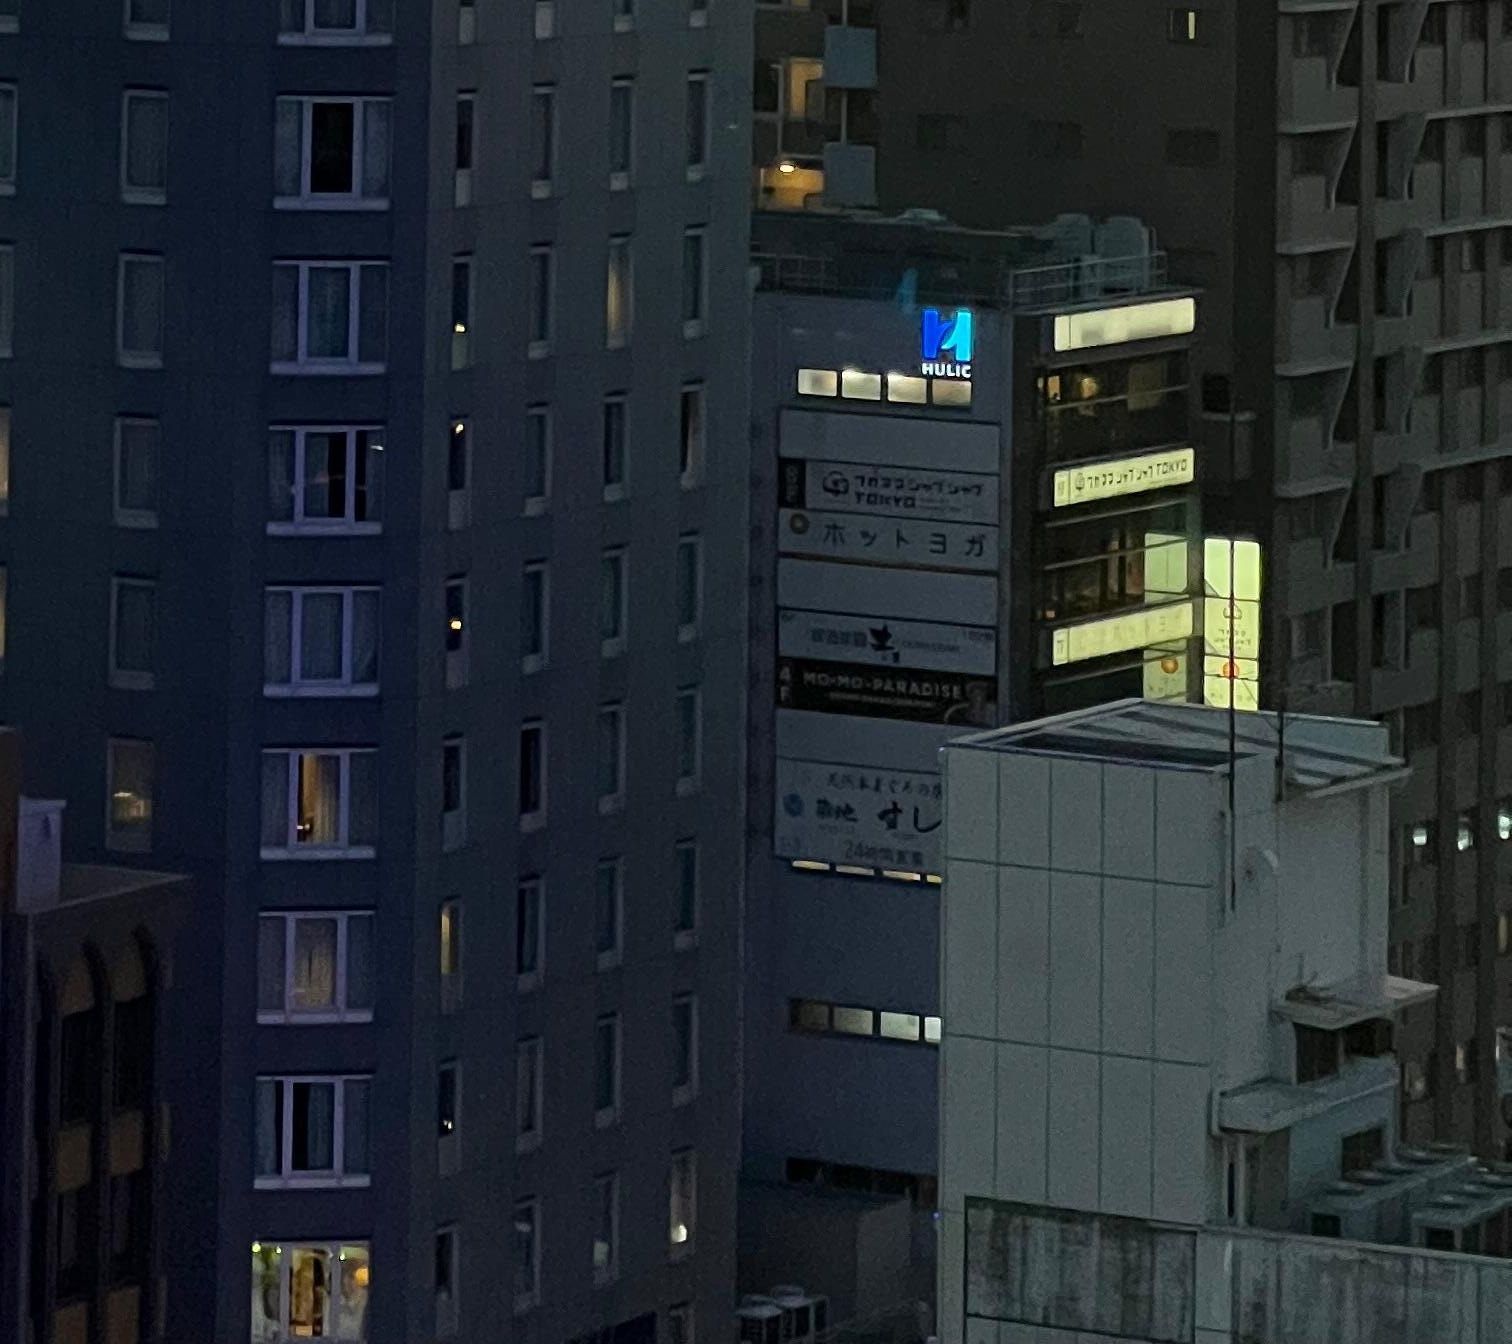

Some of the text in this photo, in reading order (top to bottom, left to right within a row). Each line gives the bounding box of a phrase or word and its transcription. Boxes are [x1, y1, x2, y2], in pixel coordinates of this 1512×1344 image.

[921, 362, 972, 379] HULIC
[854, 491, 917, 509] TOKYO
[823, 522, 987, 557] ホットヨガ
[803, 671, 962, 699] MO-MO-PARADISE
